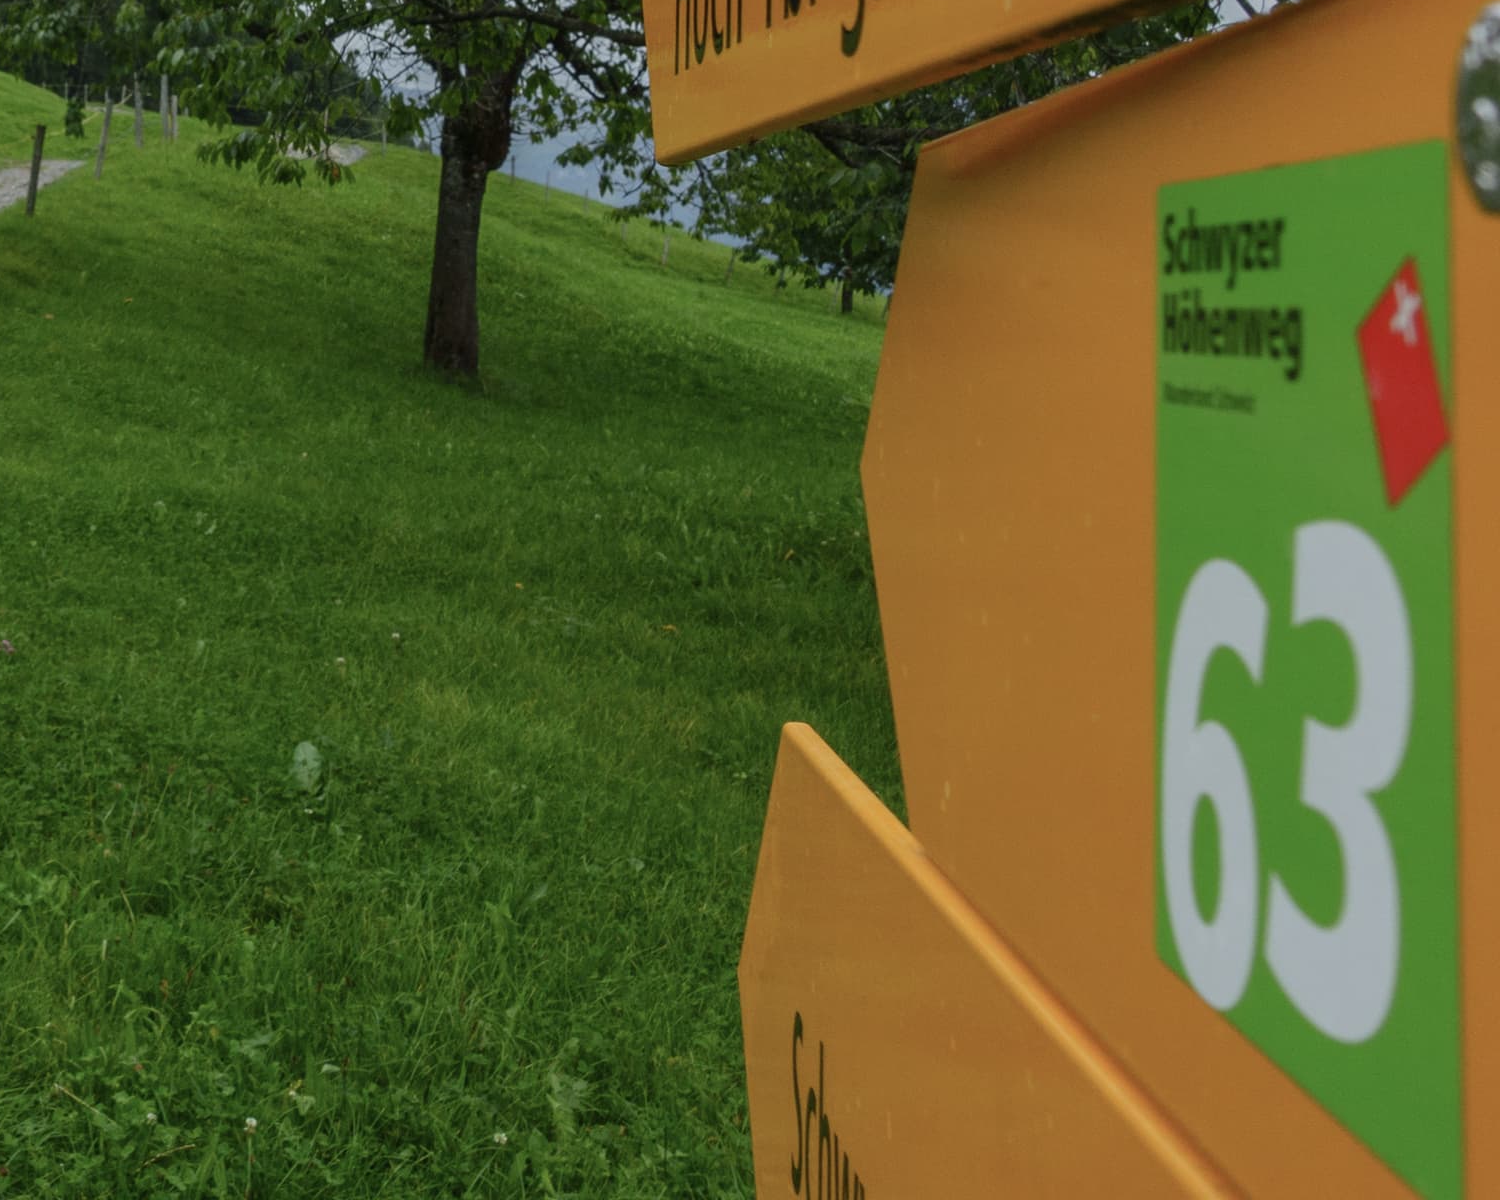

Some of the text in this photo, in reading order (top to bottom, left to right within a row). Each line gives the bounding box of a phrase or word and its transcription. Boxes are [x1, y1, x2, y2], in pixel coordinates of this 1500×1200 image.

[1163, 206, 1286, 291] Schwyzer
[1163, 288, 1304, 383] Höhenweg
[1161, 519, 1415, 1045] 63
